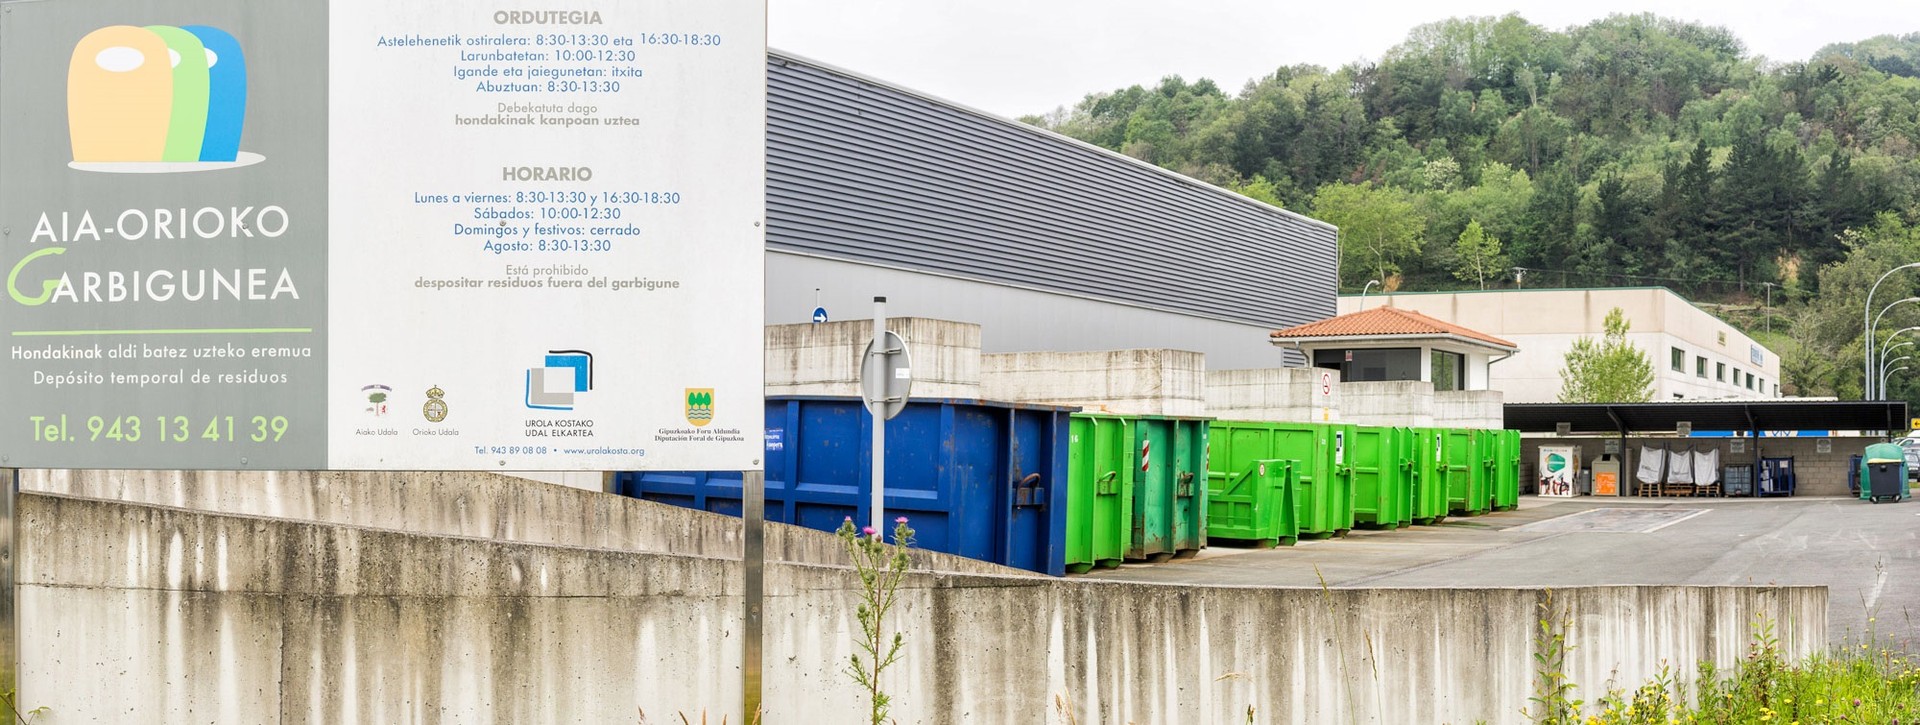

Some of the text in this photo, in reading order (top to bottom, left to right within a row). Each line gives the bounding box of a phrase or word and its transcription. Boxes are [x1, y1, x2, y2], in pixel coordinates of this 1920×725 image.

[493, 10, 603, 25] ORDUTEGIA
[377, 32, 721, 47] Astelehenetik ostiralera: 8:30-13:30 eta 16:30-18:30
[460, 49, 636, 62] Larunbatetan: 10:00-12:30
[453, 65, 643, 79] Igande eta jaiegunetan: itxita
[475, 80, 620, 93] Abuztuan: 8:30-13:30
[497, 101, 598, 116] Debekatuta dago
[455, 113, 640, 129] hondakinak kanpoan uztea
[502, 166, 593, 182] HORARIO
[414, 191, 681, 207] Lunes a viernes: 8:30-13:30 y 16:30-18:30
[474, 206, 621, 220] Sábados: 10:00-12:30
[30, 205, 289, 243] AIA-ORIOKO
[454, 222, 641, 239] Domingos y festivos: cerrado
[483, 239, 612, 255] Agosto: 8:30-13:30
[7, 247, 300, 306] GARBIGUNEA
[506, 263, 589, 279] Está prohibido
[414, 276, 680, 292] despositar residuos fuera del garbigune
[11, 342, 311, 360] Hondakinak aldi batez uzteko eremua
[33, 368, 287, 388] Depósito temporal de residuos
[30, 414, 289, 442] Tel. 943 13 41 39
[525, 419, 594, 428] UROLA KOSTAKO
[355, 428, 399, 436] Aiako Udala
[412, 428, 460, 436] Orioko Udala
[525, 429, 594, 437] UDAL ELKARTEA
[654, 435, 688, 443] Diputación
[715, 435, 745, 443] Gipuzkoa
[658, 428, 696, 436] Gipuzkoako
[474, 445, 645, 457] Tel. 943 89 08 08 www.urolakosta.org
